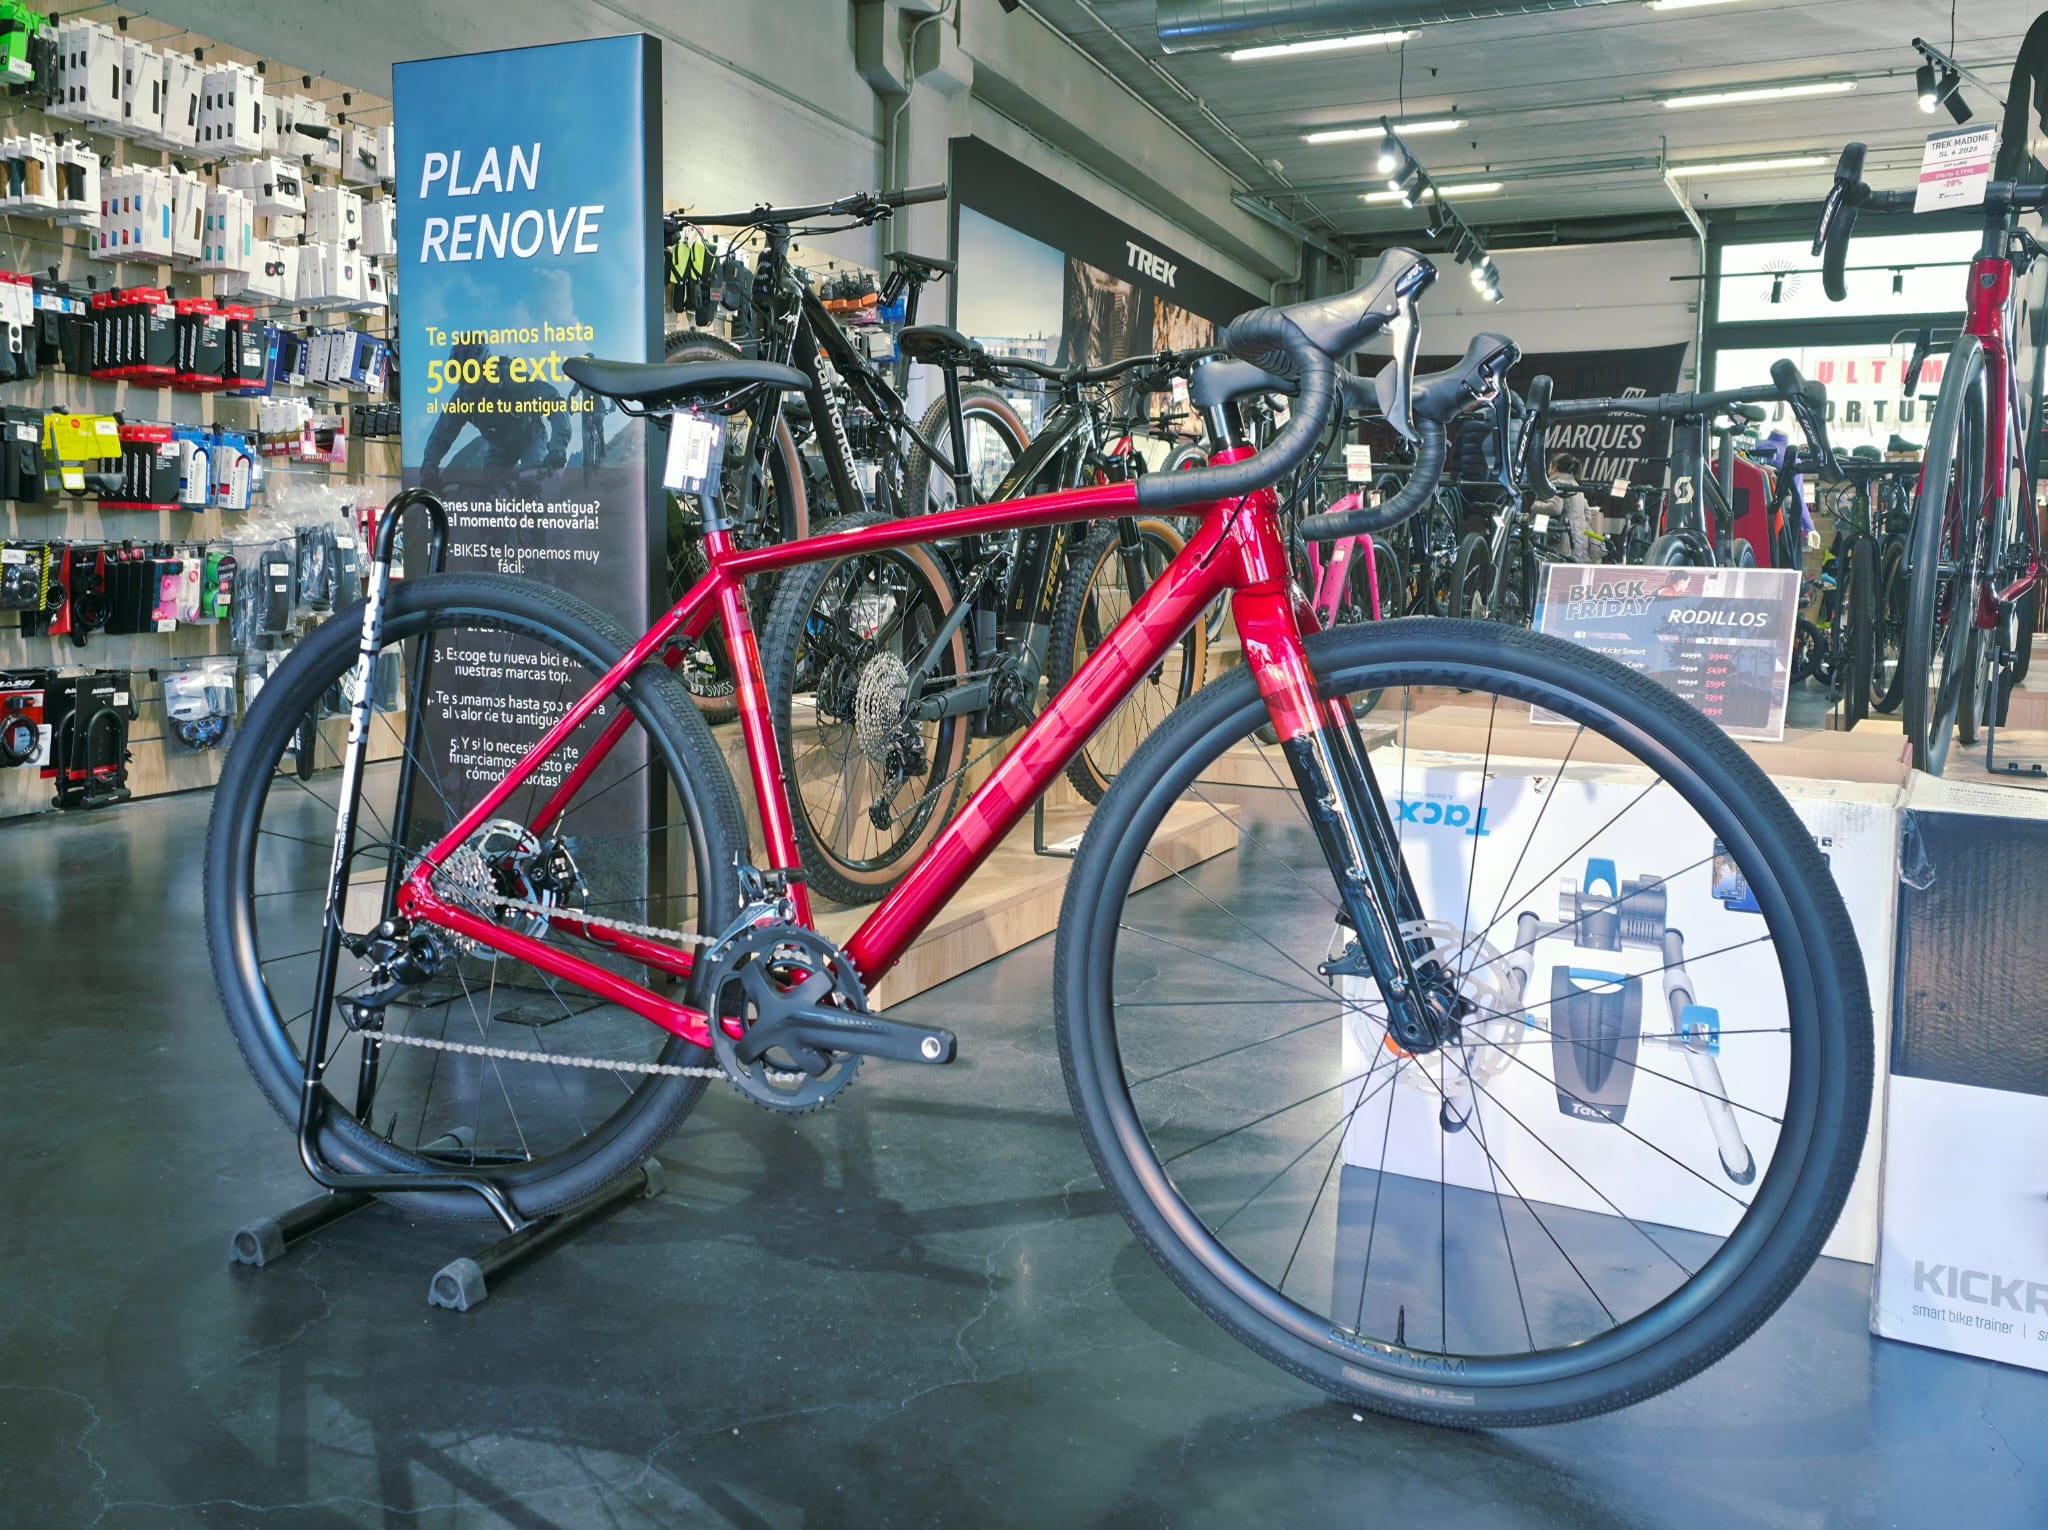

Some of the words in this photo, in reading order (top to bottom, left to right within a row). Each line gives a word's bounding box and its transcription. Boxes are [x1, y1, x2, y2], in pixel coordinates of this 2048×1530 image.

[1932, 140, 1951, 150] TREK
[1954, 133, 1990, 146] MADONE
[420, 142, 541, 199] PLAN
[420, 205, 605, 263] RENOVE
[1126, 239, 1177, 288] TREK
[426, 327, 446, 346] Te
[452, 325, 539, 345] sumamos
[544, 321, 593, 342] hasta
[427, 355, 500, 394] 500€
[509, 352, 590, 383] ext
[427, 399, 437, 413] al
[441, 398, 474, 414] valor
[478, 397, 493, 413] de
[497, 399, 512, 413] tu
[515, 397, 567, 416] antigua
[570, 396, 594, 412] bici
[1544, 424, 1646, 451] MARQUES
[471, 501, 492, 513] una
[496, 499, 544, 514] bicicleta
[547, 500, 600, 518] antigua?
[448, 514, 456, 527] el
[460, 515, 517, 528] momento
[520, 515, 534, 528] de
[537, 516, 599, 530] renovarla!
[490, 545, 500, 558] te
[504, 544, 514, 558] lo
[518, 549, 570, 562] ponemos
[574, 550, 599, 565] muy
[498, 559, 525, 574] fácil:
[1041, 531, 1067, 612] TREK
[1569, 579, 1648, 602] BLACK
[1566, 596, 1655, 620] FRIDAY
[1668, 609, 1768, 627] RODILLOS
[434, 649, 444, 662] 3.
[489, 650, 500, 662] tu
[504, 652, 537, 665] nueva
[540, 652, 560, 666] bici
[455, 666, 503, 678] nuestras
[506, 668, 547, 682] marcas
[548, 670, 572, 684] top.
[436, 691, 450, 704] Te
[509, 695, 540, 710] hasta
[442, 705, 452, 719] al
[501, 711, 514, 724] tu
[450, 738, 460, 752] 5.
[461, 736, 469, 749] Y
[472, 737, 481, 750] si
[483, 737, 494, 751] lo
[1393, 800, 1490, 837] Tacx
[1913, 1260, 2048, 1314] KICKR
[1912, 1304, 1946, 1321] smart
[1949, 1309, 1973, 1326] bike
[1976, 1315, 2014, 1334] trainer
